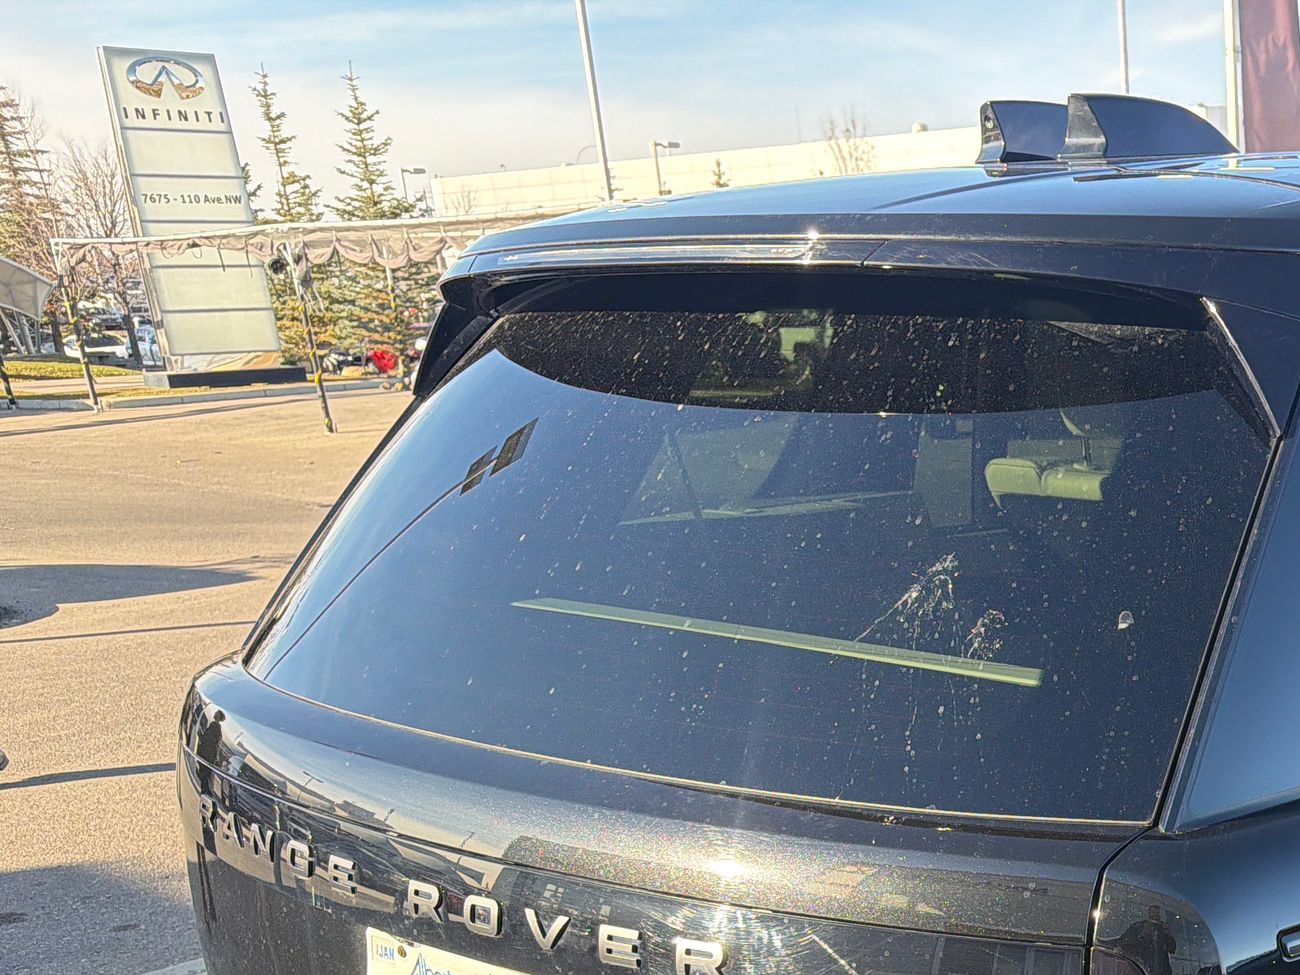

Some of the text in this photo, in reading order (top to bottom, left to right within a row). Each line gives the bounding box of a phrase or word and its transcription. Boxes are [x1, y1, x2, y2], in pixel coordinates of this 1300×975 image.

[122, 106, 226, 124] INFINITI
[141, 193, 170, 205] 7675
[179, 194, 201, 205] 110
[200, 793, 357, 897] RANGE
